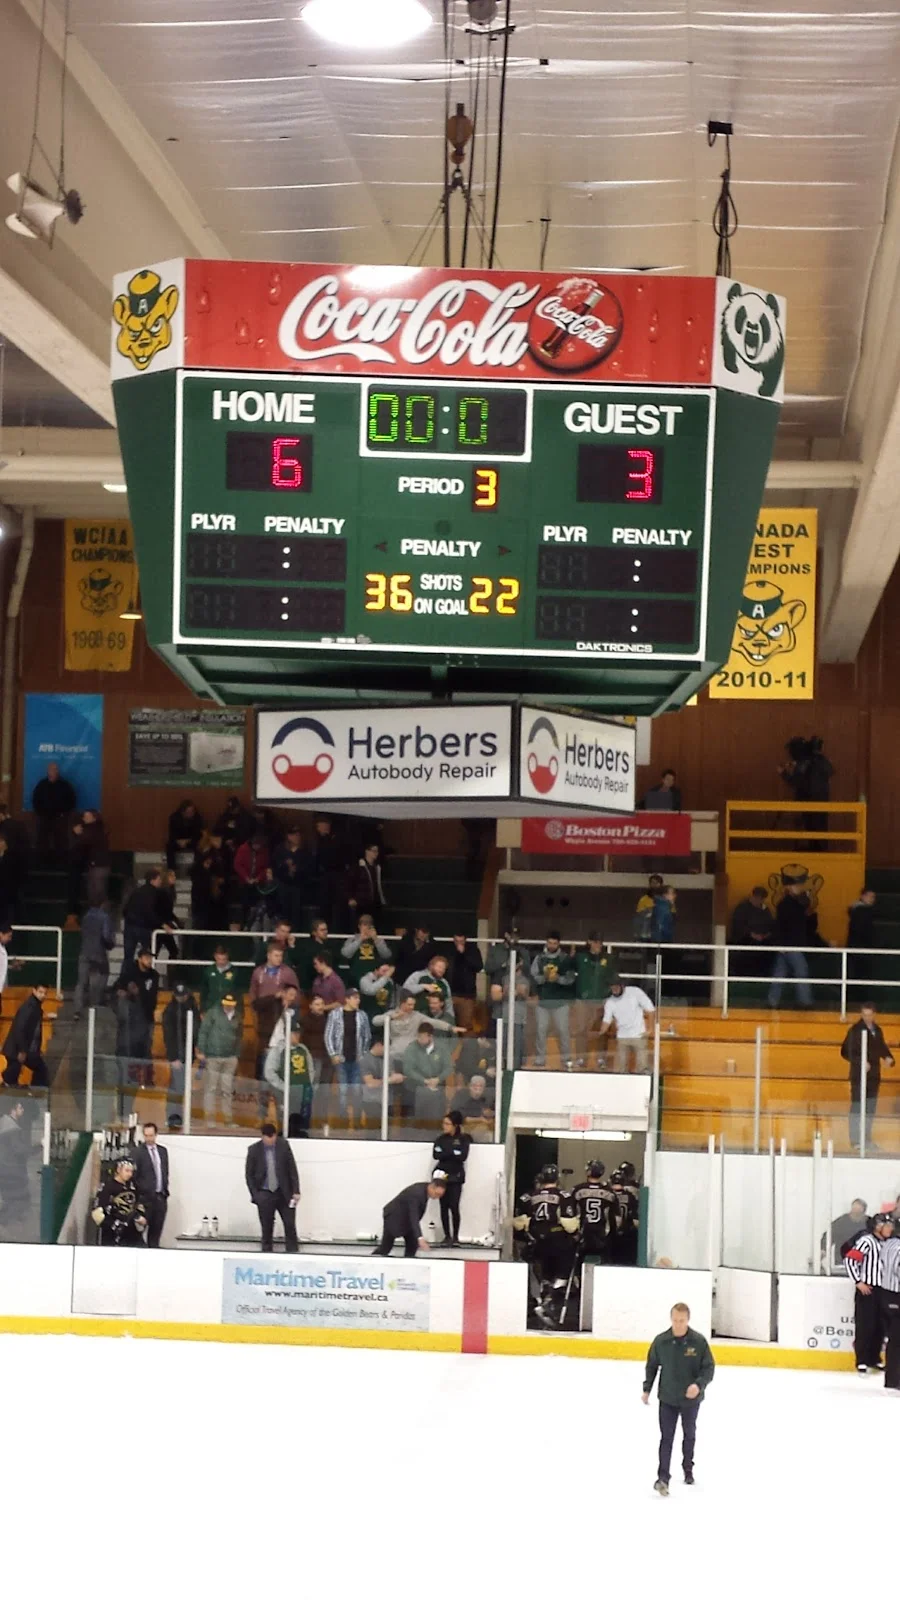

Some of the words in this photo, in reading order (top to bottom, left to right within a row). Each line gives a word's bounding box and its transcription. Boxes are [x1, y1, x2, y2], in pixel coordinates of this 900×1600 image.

[138, 298, 149, 315] A
[279, 274, 541, 367] Coca-Cola
[535, 294, 616, 348] Coca-Cola
[212, 390, 316, 424] HOME
[563, 401, 683, 436] GUEST
[272, 437, 302, 487] 6
[625, 450, 654, 499] 3
[398, 476, 465, 495] PERIOD
[474, 469, 498, 507] 3
[191, 513, 236, 531] PLYR
[264, 515, 346, 534] PENALTY
[755, 523, 809, 538] NADA
[73, 526, 128, 545] WCIAA
[543, 525, 588, 543] PLYR
[612, 528, 692, 546] PENALTY
[401, 539, 481, 558] PENALTY
[754, 543, 795, 558] EST
[749, 563, 811, 575] MPIONS
[420, 573, 463, 591] SHOTS
[365, 573, 413, 611] 36
[469, 577, 520, 614] 22
[413, 597, 433, 614] ON
[435, 598, 469, 615] GOAL
[752, 604, 765, 618] A
[576, 641, 653, 653] DAKTRONICS
[716, 671, 806, 688] 2010-11
[348, 725, 498, 759] Herbers
[565, 731, 630, 774] Herbers
[348, 763, 433, 782] Autobody
[440, 762, 497, 781] Repair
[564, 770, 603, 792] Autobody
[604, 776, 629, 794] Repair
[535, 1202, 550, 1221] 4
[586, 1198, 601, 1223] 5
[234, 1266, 326, 1289] Maritime
[326, 1270, 384, 1291] Travel
[265, 1290, 388, 1302] www.maritimetravel.ca
[813, 1325, 853, 1337] @Bea
